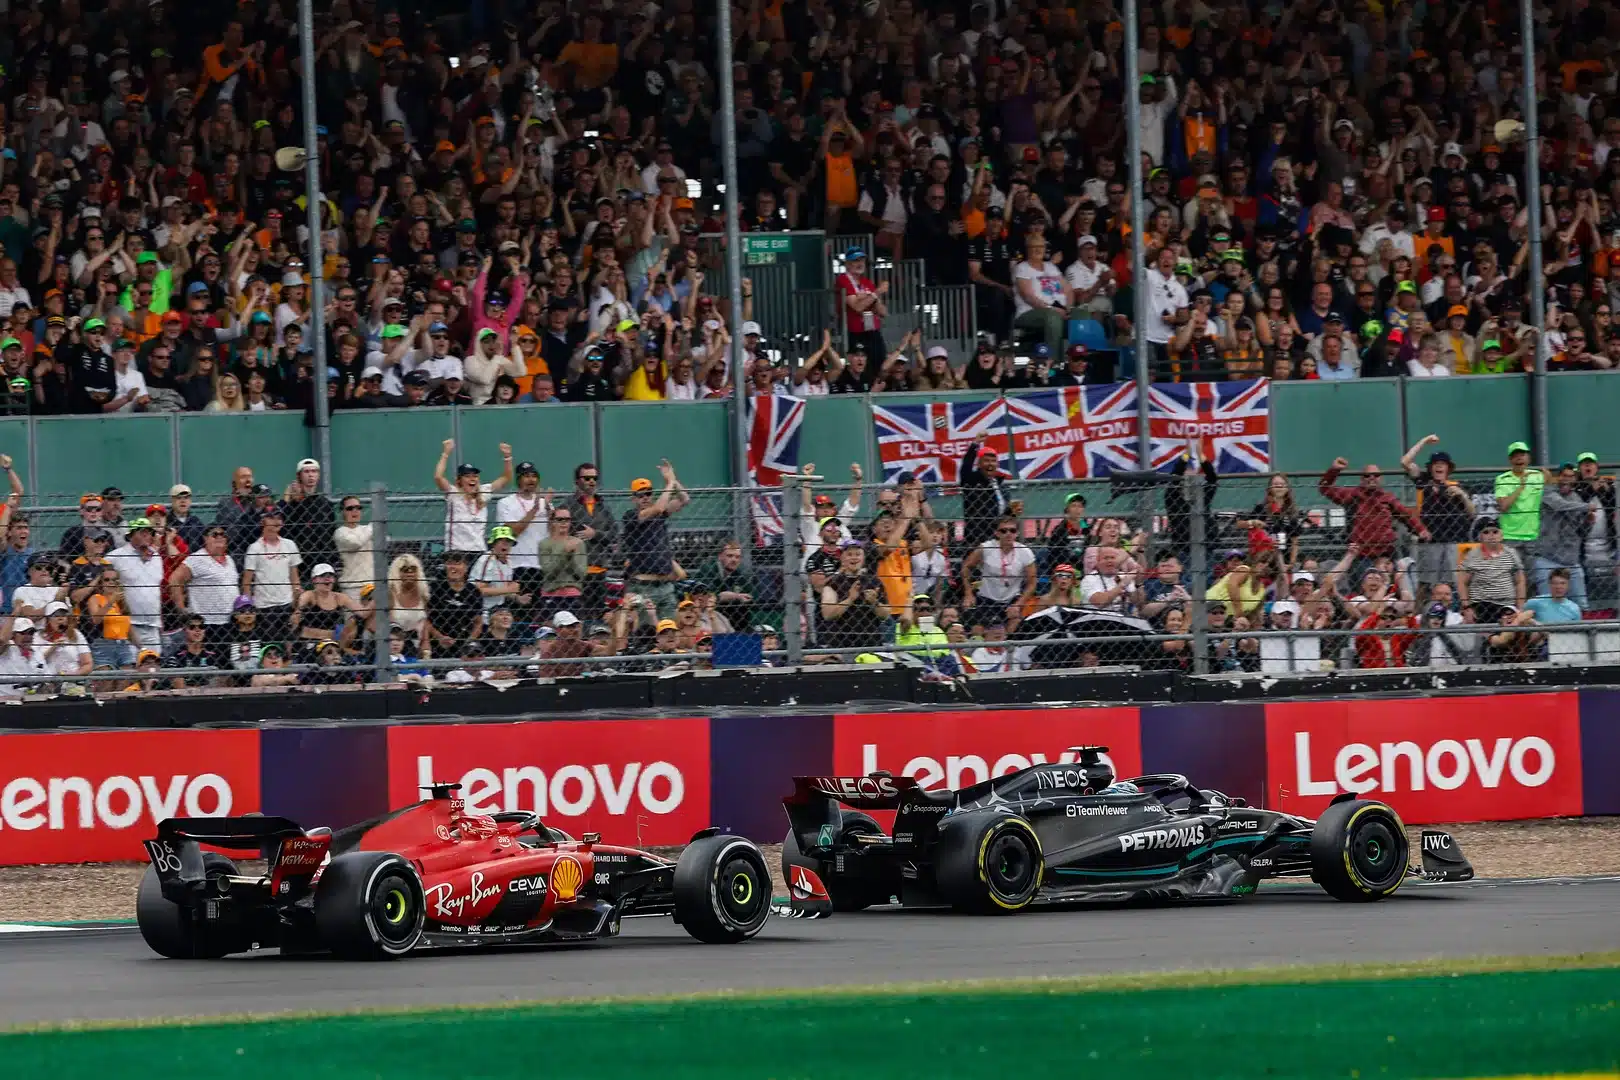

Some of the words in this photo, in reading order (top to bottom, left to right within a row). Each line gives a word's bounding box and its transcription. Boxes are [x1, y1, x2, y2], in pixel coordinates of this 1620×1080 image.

[751, 240, 769, 249] FIRE
[771, 240, 788, 249] EXIT
[1024, 421, 1130, 449] HAMILTON
[1168, 420, 1246, 436] NORRIS
[900, 437, 985, 457] RUSSE
[1295, 731, 1555, 796] Lenovo
[815, 777, 899, 799] INEOS
[1034, 768, 1089, 790] INEOS
[0, 773, 233, 830] enovo
[913, 804, 947, 813] Snapdragon
[1076, 803, 1128, 816] TeamViewer
[1227, 820, 1258, 829] AMG
[1120, 825, 1205, 853] PETRONAS
[1423, 834, 1451, 850] IWC
[526, 888, 548, 896] LOGISTICS
